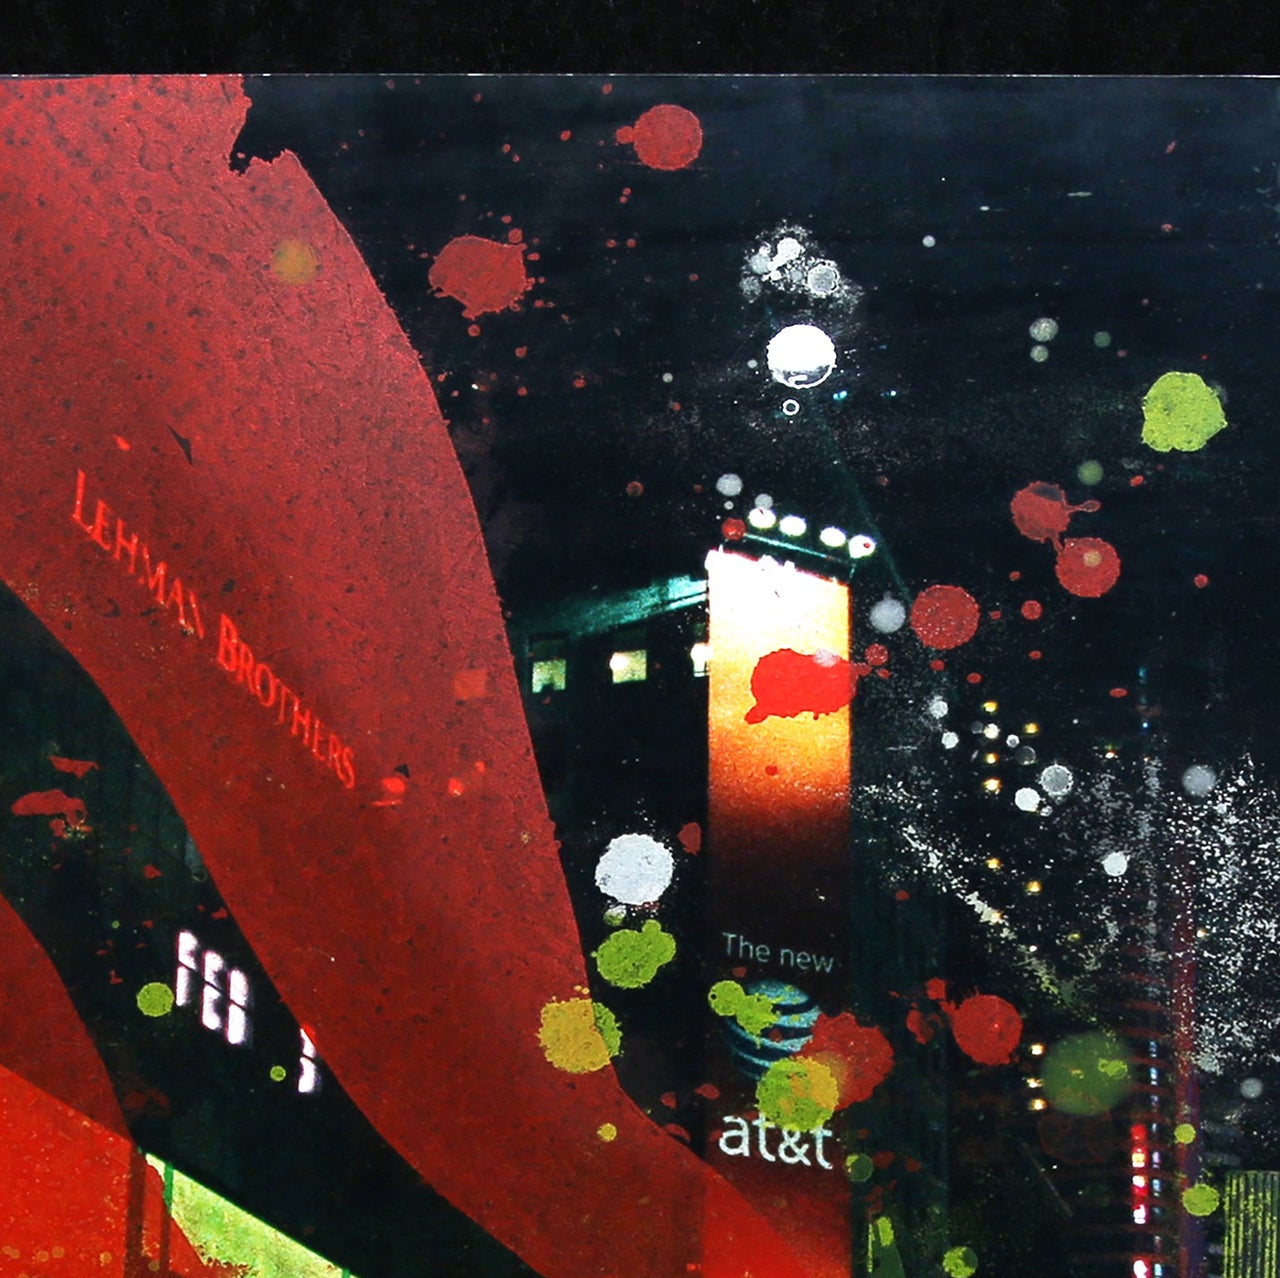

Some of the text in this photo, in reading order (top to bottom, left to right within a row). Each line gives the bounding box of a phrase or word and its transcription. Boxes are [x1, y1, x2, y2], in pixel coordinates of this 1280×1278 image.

[217, 611, 356, 790] BROTHERS
[722, 931, 834, 974] The new
[718, 1112, 833, 1170] at&t
